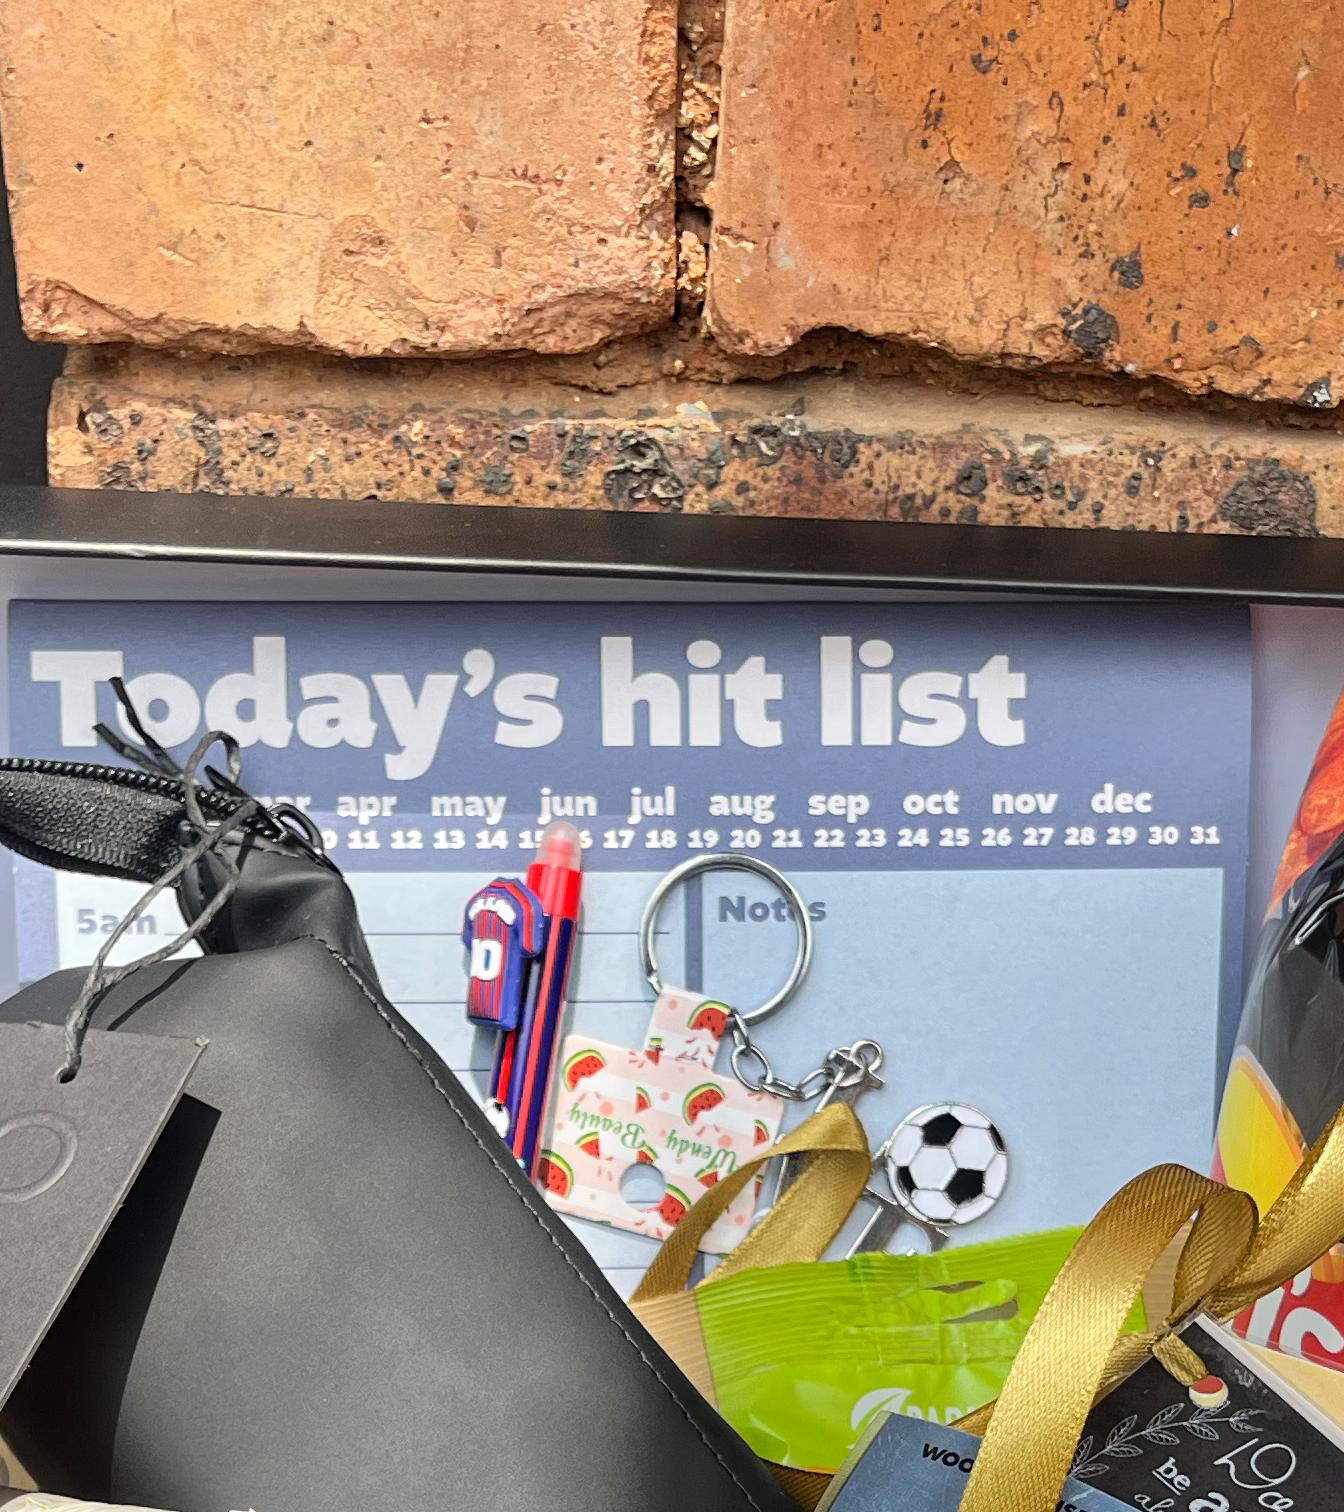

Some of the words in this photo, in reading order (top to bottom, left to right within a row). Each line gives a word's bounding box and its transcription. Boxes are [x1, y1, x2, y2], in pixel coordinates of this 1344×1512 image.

[30, 635, 564, 781] Today's
[600, 635, 783, 747] hit
[819, 635, 1027, 747] list
[337, 795, 397, 826] apr
[430, 793, 507, 826] may
[537, 786, 599, 825] jun
[627, 786, 677, 825] jul
[708, 790, 776, 824] aug
[807, 790, 871, 823] sep
[902, 788, 961, 815] oct
[992, 790, 1059, 815] nov
[1090, 783, 1154, 815] dec
[348, 830, 381, 850] 11
[391, 830, 424, 850] 12
[433, 830, 466, 850] 13
[476, 830, 509, 850] 14
[603, 829, 634, 849] 17
[645, 828, 677, 849] 18
[687, 828, 720, 849] 19
[729, 828, 762, 849] 20
[771, 827, 803, 848] 21
[813, 827, 846, 848] 22
[855, 827, 887, 848] 23
[896, 827, 930, 848] 24
[938, 826, 970, 847] 25
[980, 826, 1013, 847] 26
[1022, 826, 1054, 847] 27
[1064, 826, 1096, 847] 28
[1105, 825, 1138, 846] 29
[1147, 825, 1179, 846] 30
[1189, 825, 1221, 846] 31
[568, 1101, 646, 1149] Beauty
[665, 1128, 738, 1176] Wendy
[1154, 1455, 1193, 1492] be
